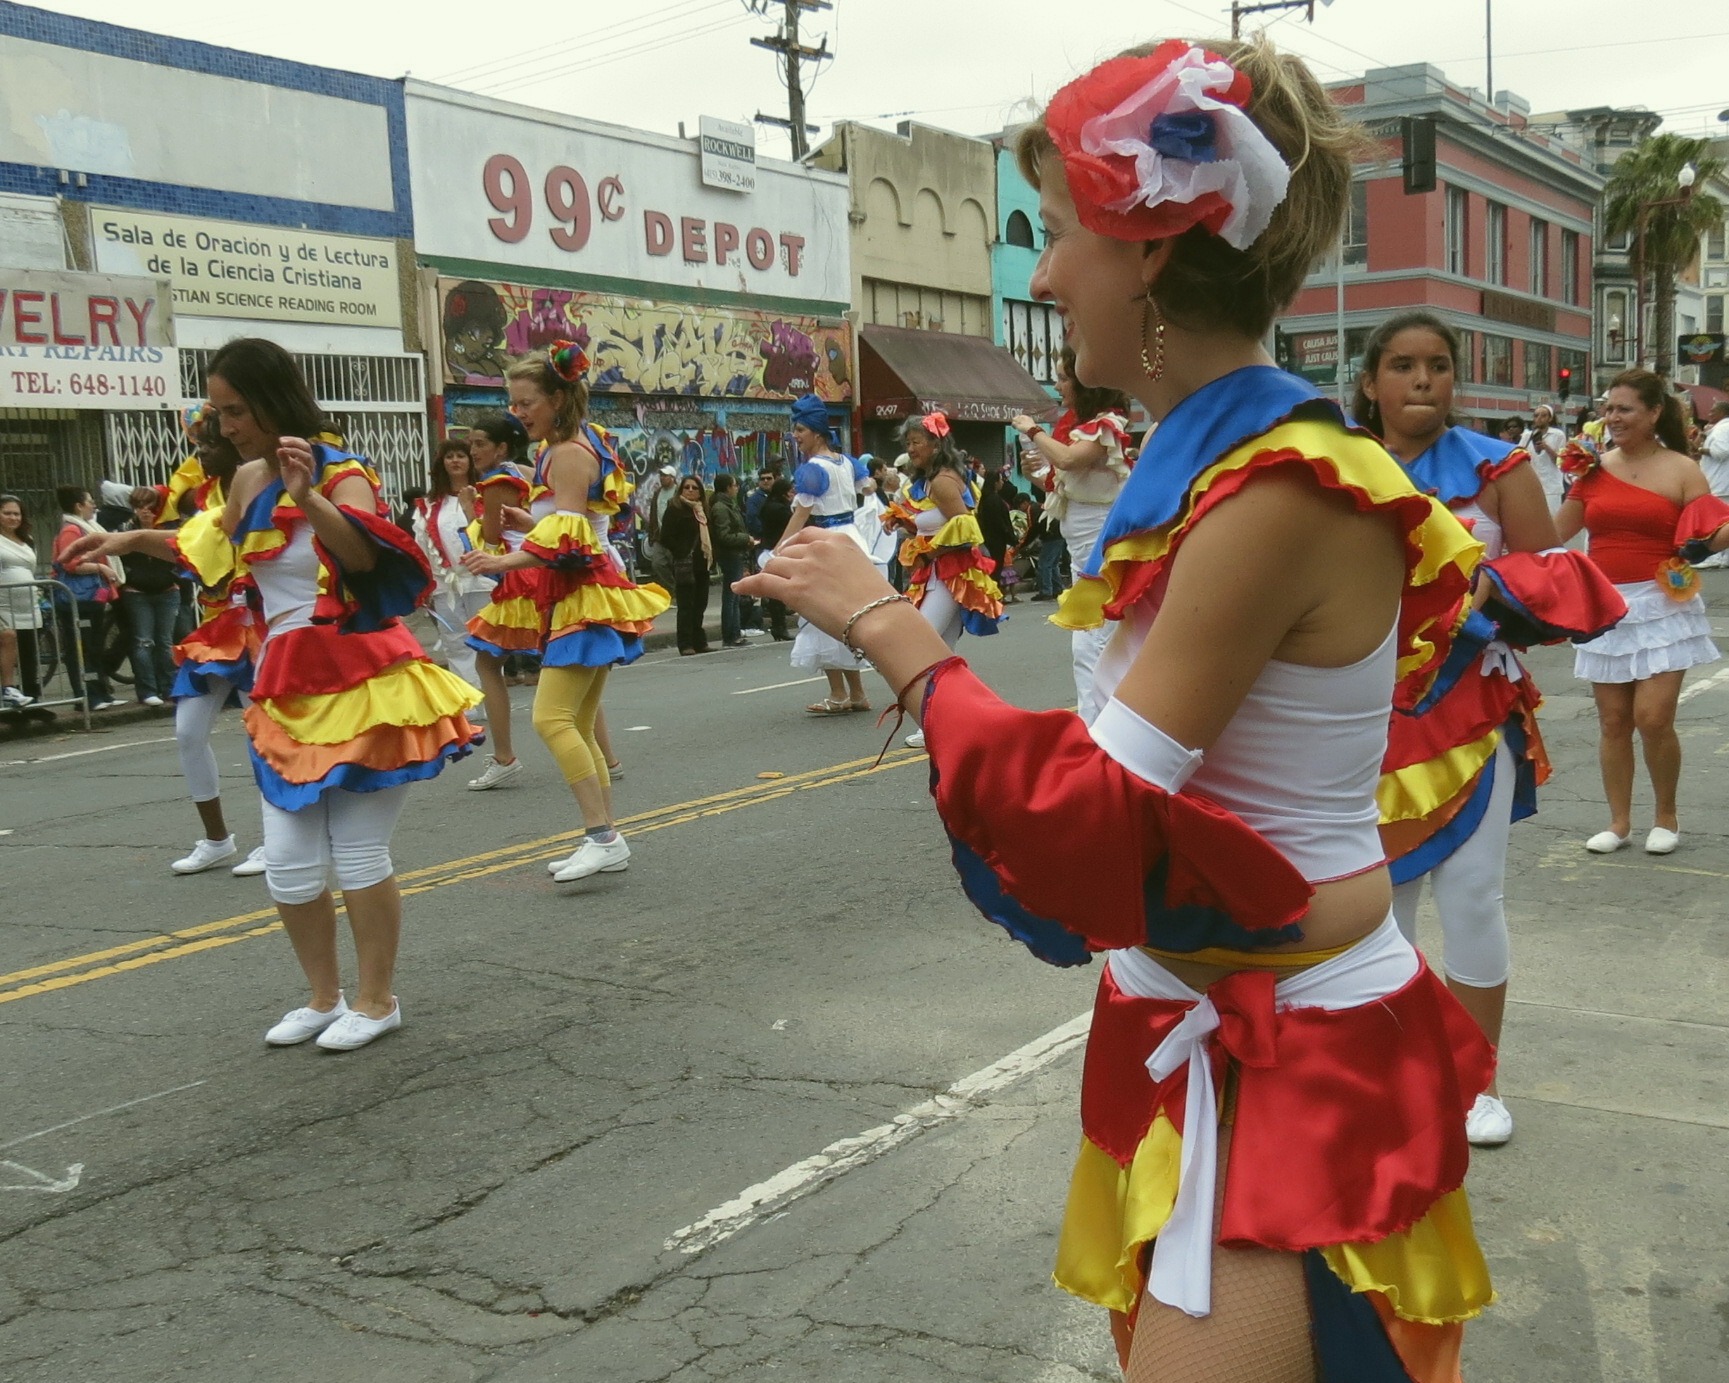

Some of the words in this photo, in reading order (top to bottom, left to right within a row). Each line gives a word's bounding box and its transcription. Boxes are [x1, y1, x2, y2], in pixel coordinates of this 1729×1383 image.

[704, 138, 753, 160] ROCKWELL
[718, 170, 755, 189] 398-2400
[103, 222, 154, 246] Sala
[162, 228, 187, 249] de
[195, 231, 271, 258] Oración
[279, 244, 290, 263] y
[297, 242, 318, 262] de
[324, 245, 389, 269] Lectura
[644, 210, 806, 276] DEPOT
[147, 254, 172, 274] de
[180, 256, 199, 277] la
[207, 259, 275, 283] Ciencia
[282, 266, 362, 291] Cristiana
[216, 291, 274, 309] SCIENCE
[278, 296, 335, 314] READING
[340, 301, 377, 316] ROOM
[0, 288, 155, 347] ELRY
[1326, 335, 1338, 346] JUS
[1321, 351, 1338, 362] CAUS
[12, 371, 62, 395] TEL:
[70, 373, 166, 397] 648-1140
